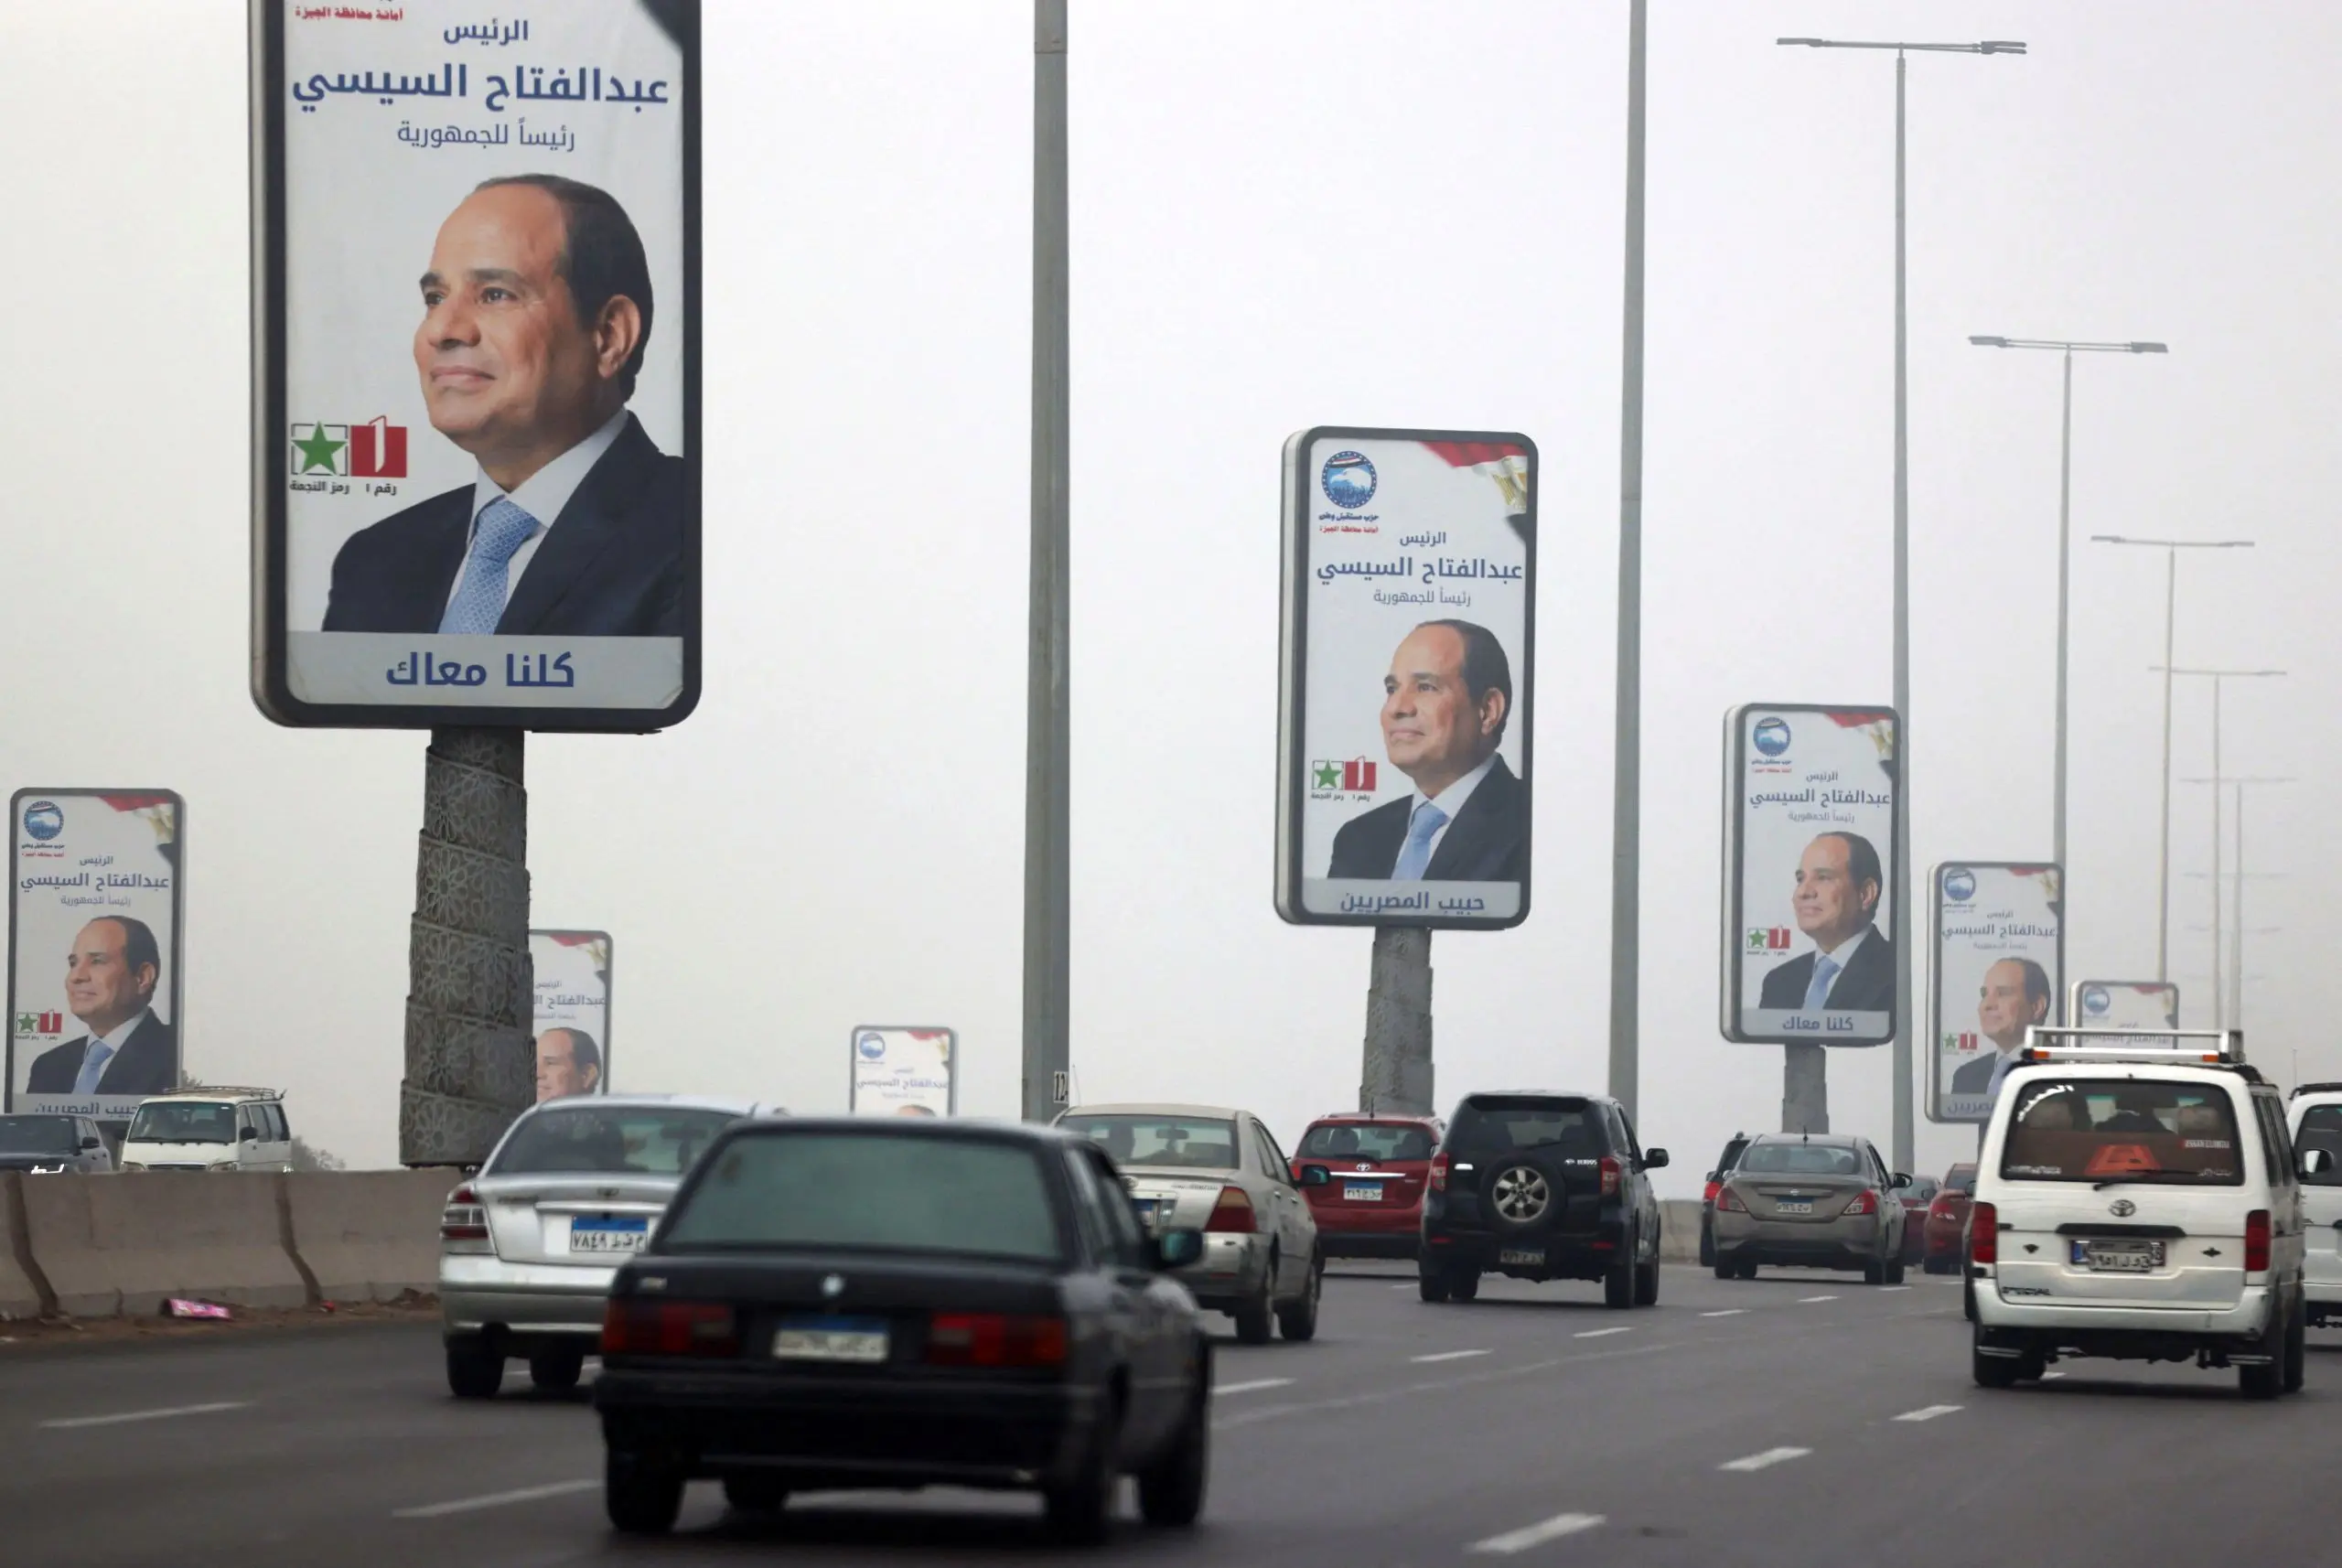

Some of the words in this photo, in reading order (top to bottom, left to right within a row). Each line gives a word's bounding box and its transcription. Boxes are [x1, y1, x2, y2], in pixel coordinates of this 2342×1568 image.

[444, 19, 529, 46] الرئيس
[292, 63, 467, 112] السيسي
[486, 65, 669, 113] عبدالفتاح
[397, 120, 508, 148] للجمهورية
[289, 480, 327, 494] النجمة
[330, 482, 350, 495] رمز
[374, 482, 397, 497] رقم
[1399, 531, 1446, 547] الرئيس
[1316, 556, 1413, 585] السيسي
[1422, 558, 1523, 585] عبدالفتاح
[1373, 588, 1434, 605] للجمهورية
[385, 651, 488, 686] معاك
[506, 650, 575, 688] كلنا
[1749, 789, 1815, 809] السيسي
[1820, 789, 1891, 809] عبدالفتاح
[20, 872, 90, 893] السيسي
[96, 872, 169, 891] عبدالفتاح
[1339, 891, 1430, 914] المصريين
[1437, 897, 1485, 915] حبيب
[1782, 1015, 1821, 1030] معاك
[1827, 1016, 1853, 1031] كلنا
